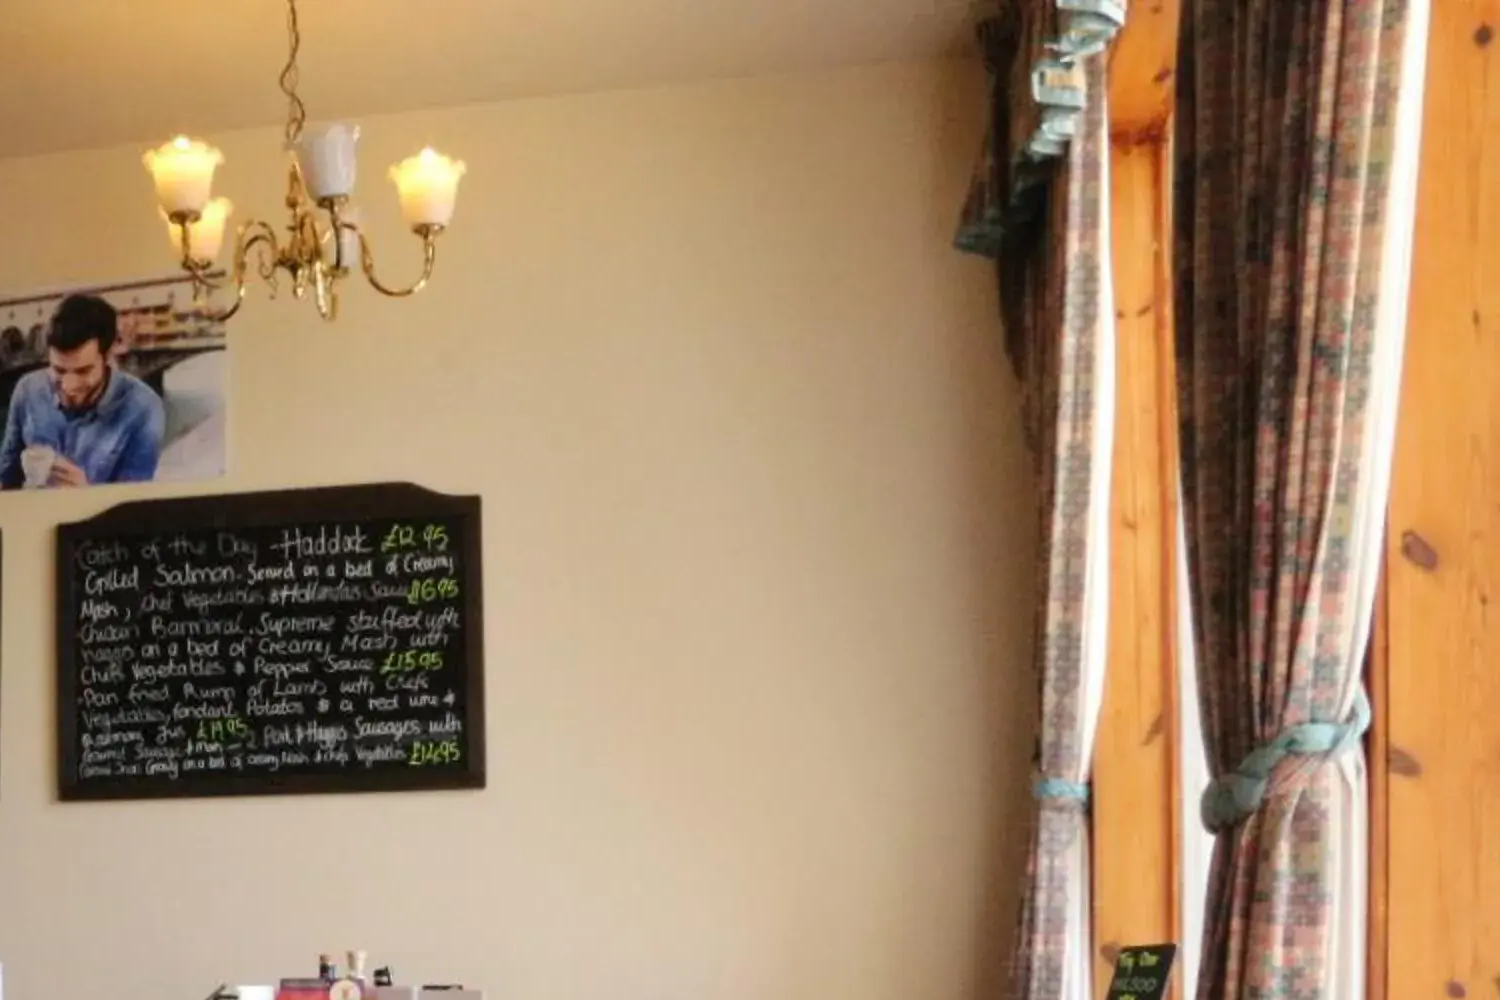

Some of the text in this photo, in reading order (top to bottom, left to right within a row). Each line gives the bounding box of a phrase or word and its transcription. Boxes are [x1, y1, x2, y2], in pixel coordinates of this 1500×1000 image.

[141, 538, 161, 563] of
[167, 535, 207, 555] the
[216, 533, 257, 563] Day
[85, 564, 139, 596] Grilled
[303, 564, 320, 578] on
[325, 563, 336, 577] a
[345, 559, 373, 578] bed
[385, 553, 400, 576] of
[256, 611, 335, 637] Supreme
[141, 643, 160, 657] on
[167, 641, 178, 656] a
[187, 638, 219, 656] bed
[229, 636, 251, 656] of
[341, 633, 398, 651] Mash
[132, 658, 226, 685] Vegetables
[324, 654, 375, 673] Sauce
[183, 682, 236, 702] Rump
[248, 679, 266, 698] of
[272, 679, 327, 697] Lamb
[340, 700, 353, 711] a
[369, 695, 398, 710] red
[354, 715, 421, 742] Sausages
[429, 712, 462, 732] with
